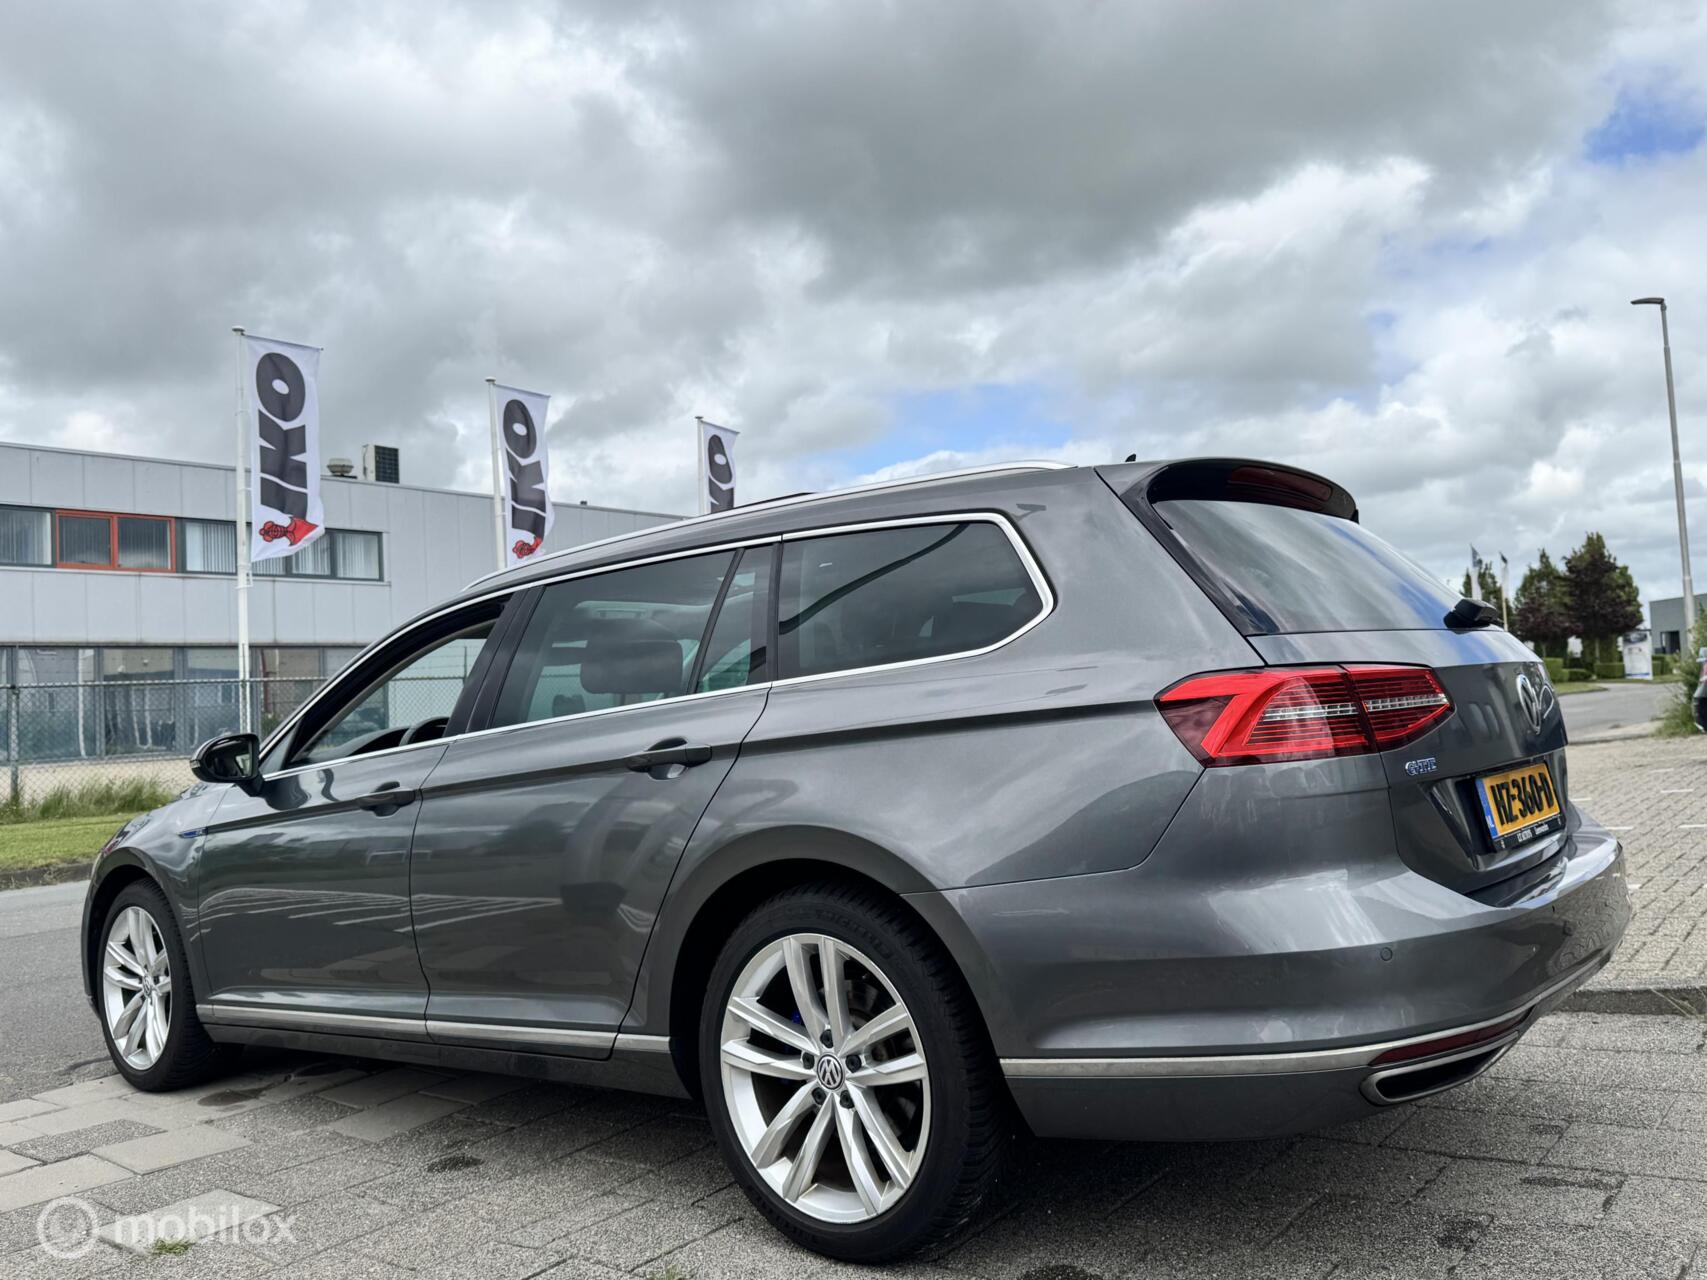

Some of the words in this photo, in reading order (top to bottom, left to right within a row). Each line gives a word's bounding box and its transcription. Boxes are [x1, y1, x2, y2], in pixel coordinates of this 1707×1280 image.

[255, 352, 308, 517] IKO
[503, 399, 546, 537] IKO
[707, 434, 735, 512] KO
[1405, 757, 1437, 776] GTE
[1491, 773, 1553, 825] HZ-360-D
